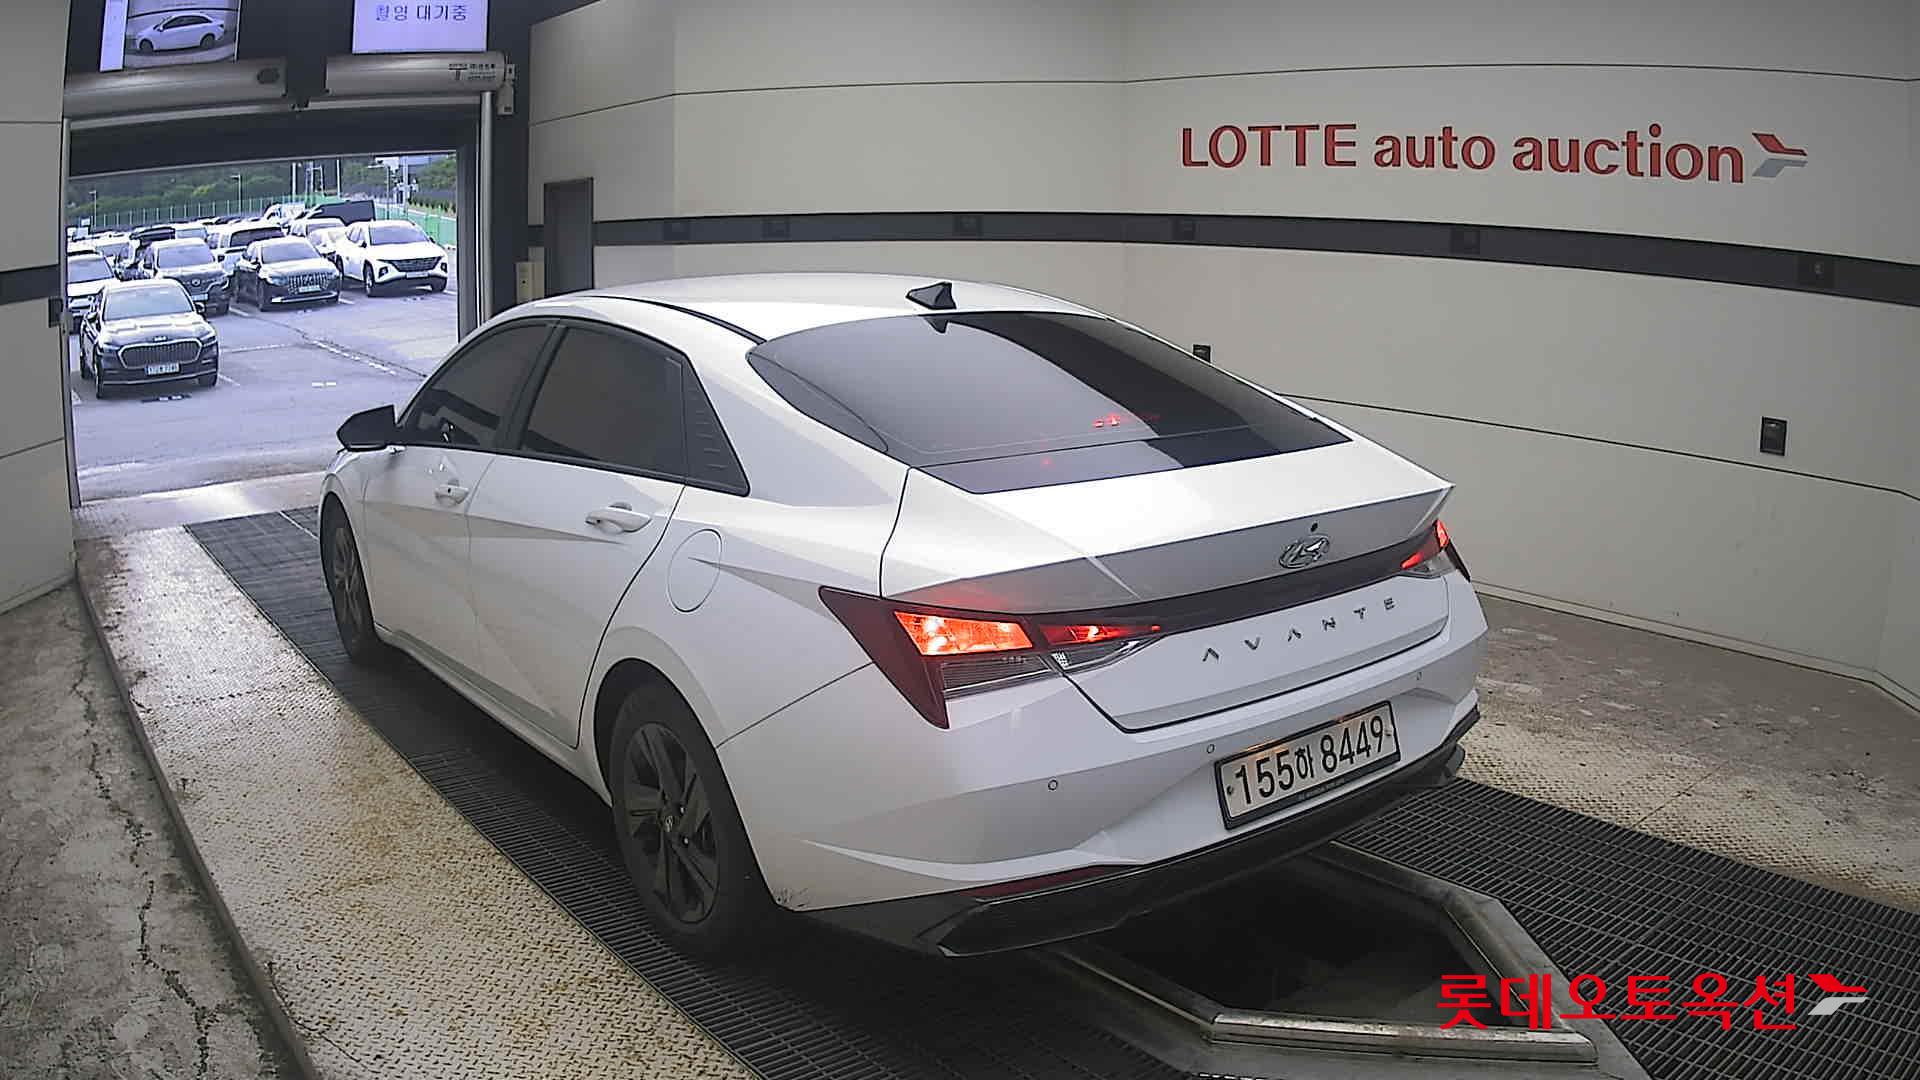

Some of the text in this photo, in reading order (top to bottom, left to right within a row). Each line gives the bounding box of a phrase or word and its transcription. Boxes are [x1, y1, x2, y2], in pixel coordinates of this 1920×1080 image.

[416, 4, 467, 21] 대기중
[1181, 123, 1744, 184] LOTTE auto auction
[1202, 597, 1396, 662] AVANTE
[1235, 715, 1384, 804] 155하 8449
